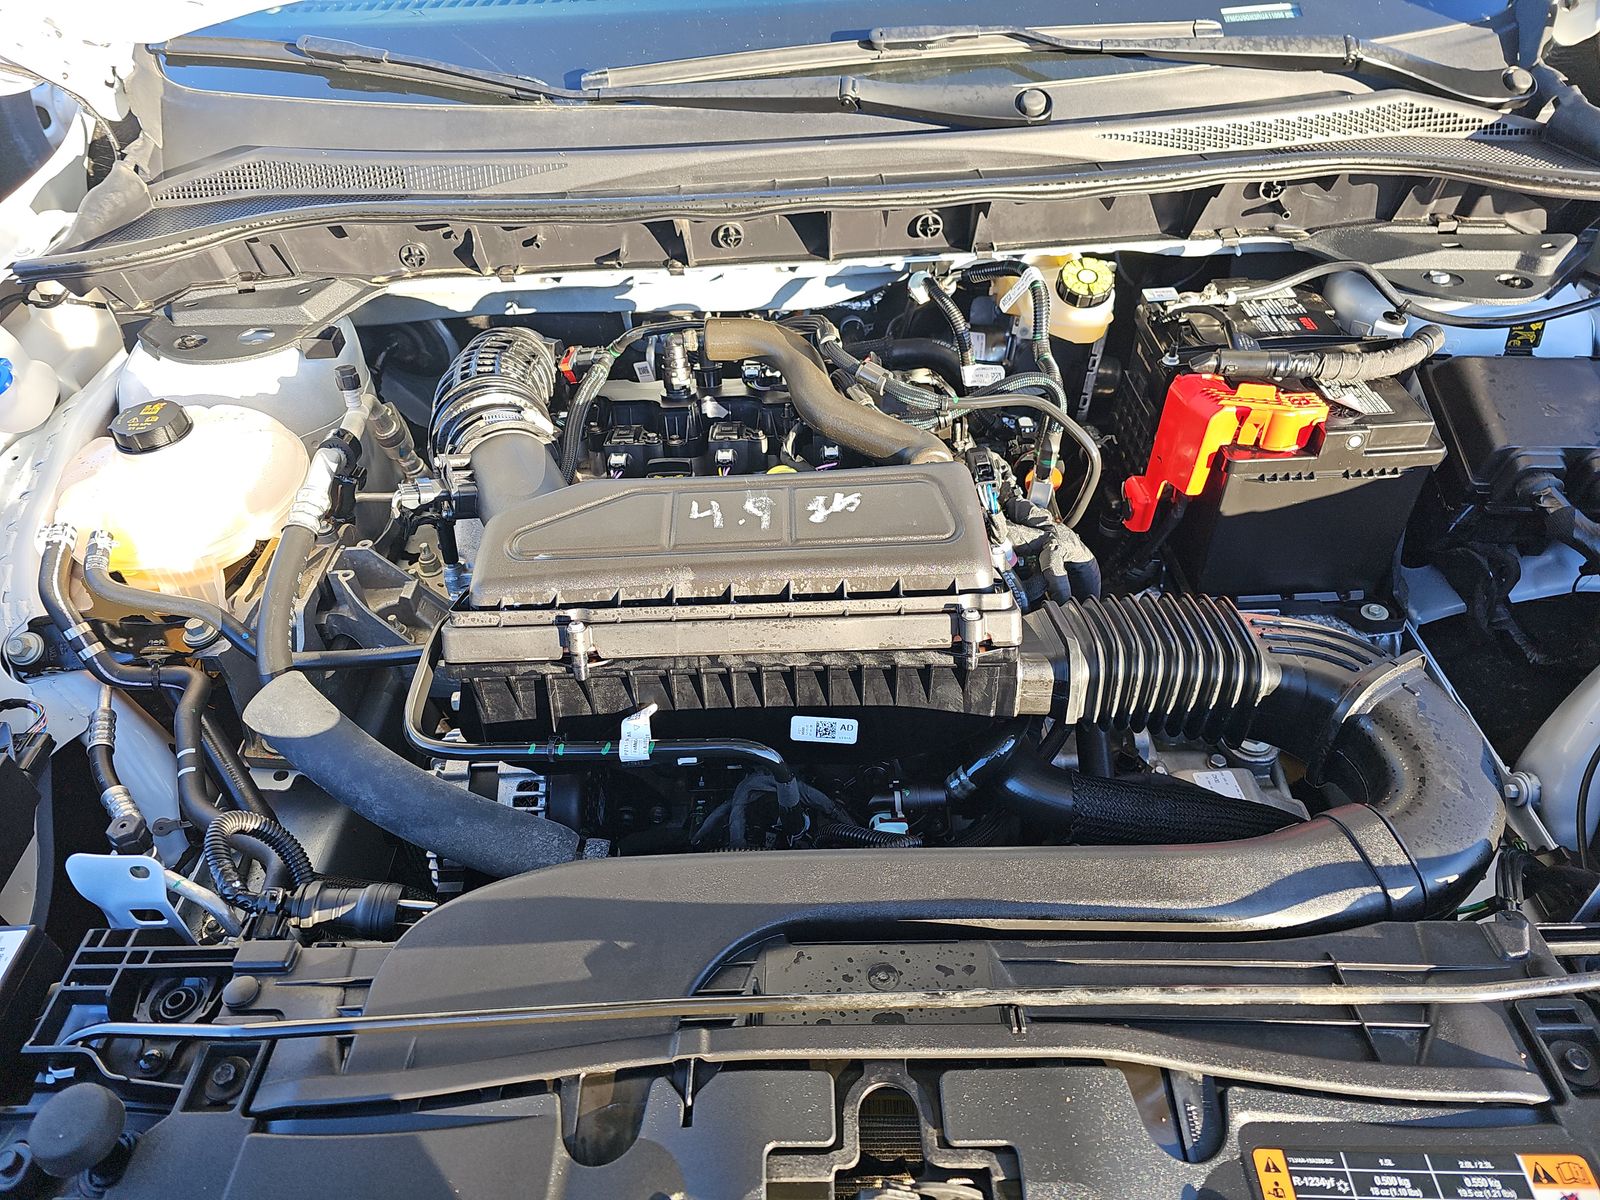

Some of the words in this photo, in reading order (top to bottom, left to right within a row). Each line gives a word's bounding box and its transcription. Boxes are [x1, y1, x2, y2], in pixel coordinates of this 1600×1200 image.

[840, 723, 854, 732] AD
[1292, 1176, 1335, 1189] R-1234yf
[1373, 1176, 1398, 1187] 0.500
[1398, 1176, 1411, 1188] kg
[1463, 1176, 1488, 1188] 0.550
[1488, 1176, 1502, 1190] kg
